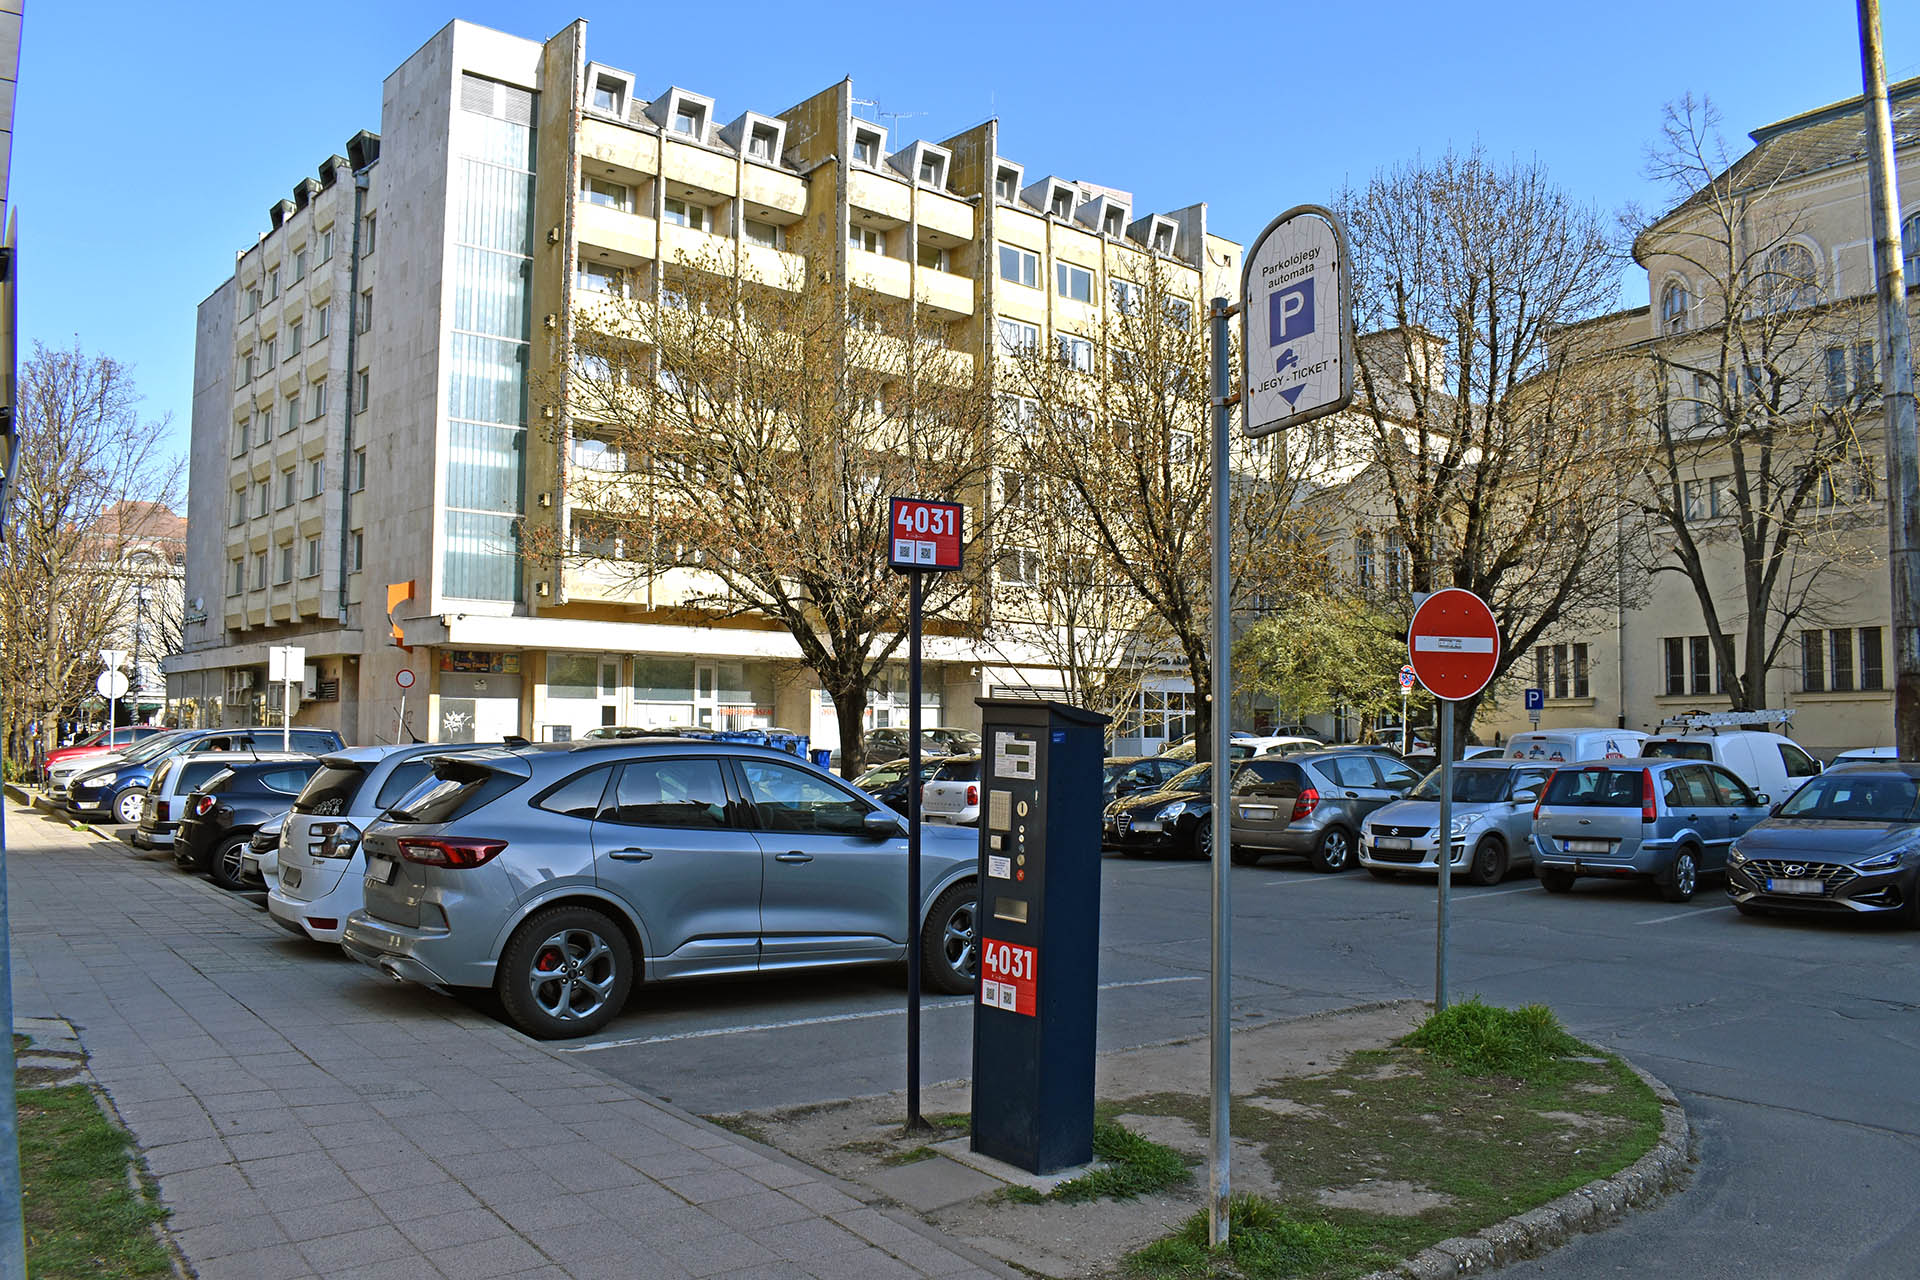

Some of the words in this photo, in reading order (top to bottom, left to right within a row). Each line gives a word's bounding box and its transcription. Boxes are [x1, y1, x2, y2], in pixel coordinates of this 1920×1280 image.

[1262, 247, 1321, 277] Parkolójegy
[1268, 264, 1314, 288] automata
[1279, 291, 1304, 338] P
[1258, 376, 1283, 393] JEGY
[1292, 361, 1328, 381] TICKET
[898, 505, 954, 535] 4031
[1529, 691, 1540, 707] P
[985, 942, 1032, 980] 4031
